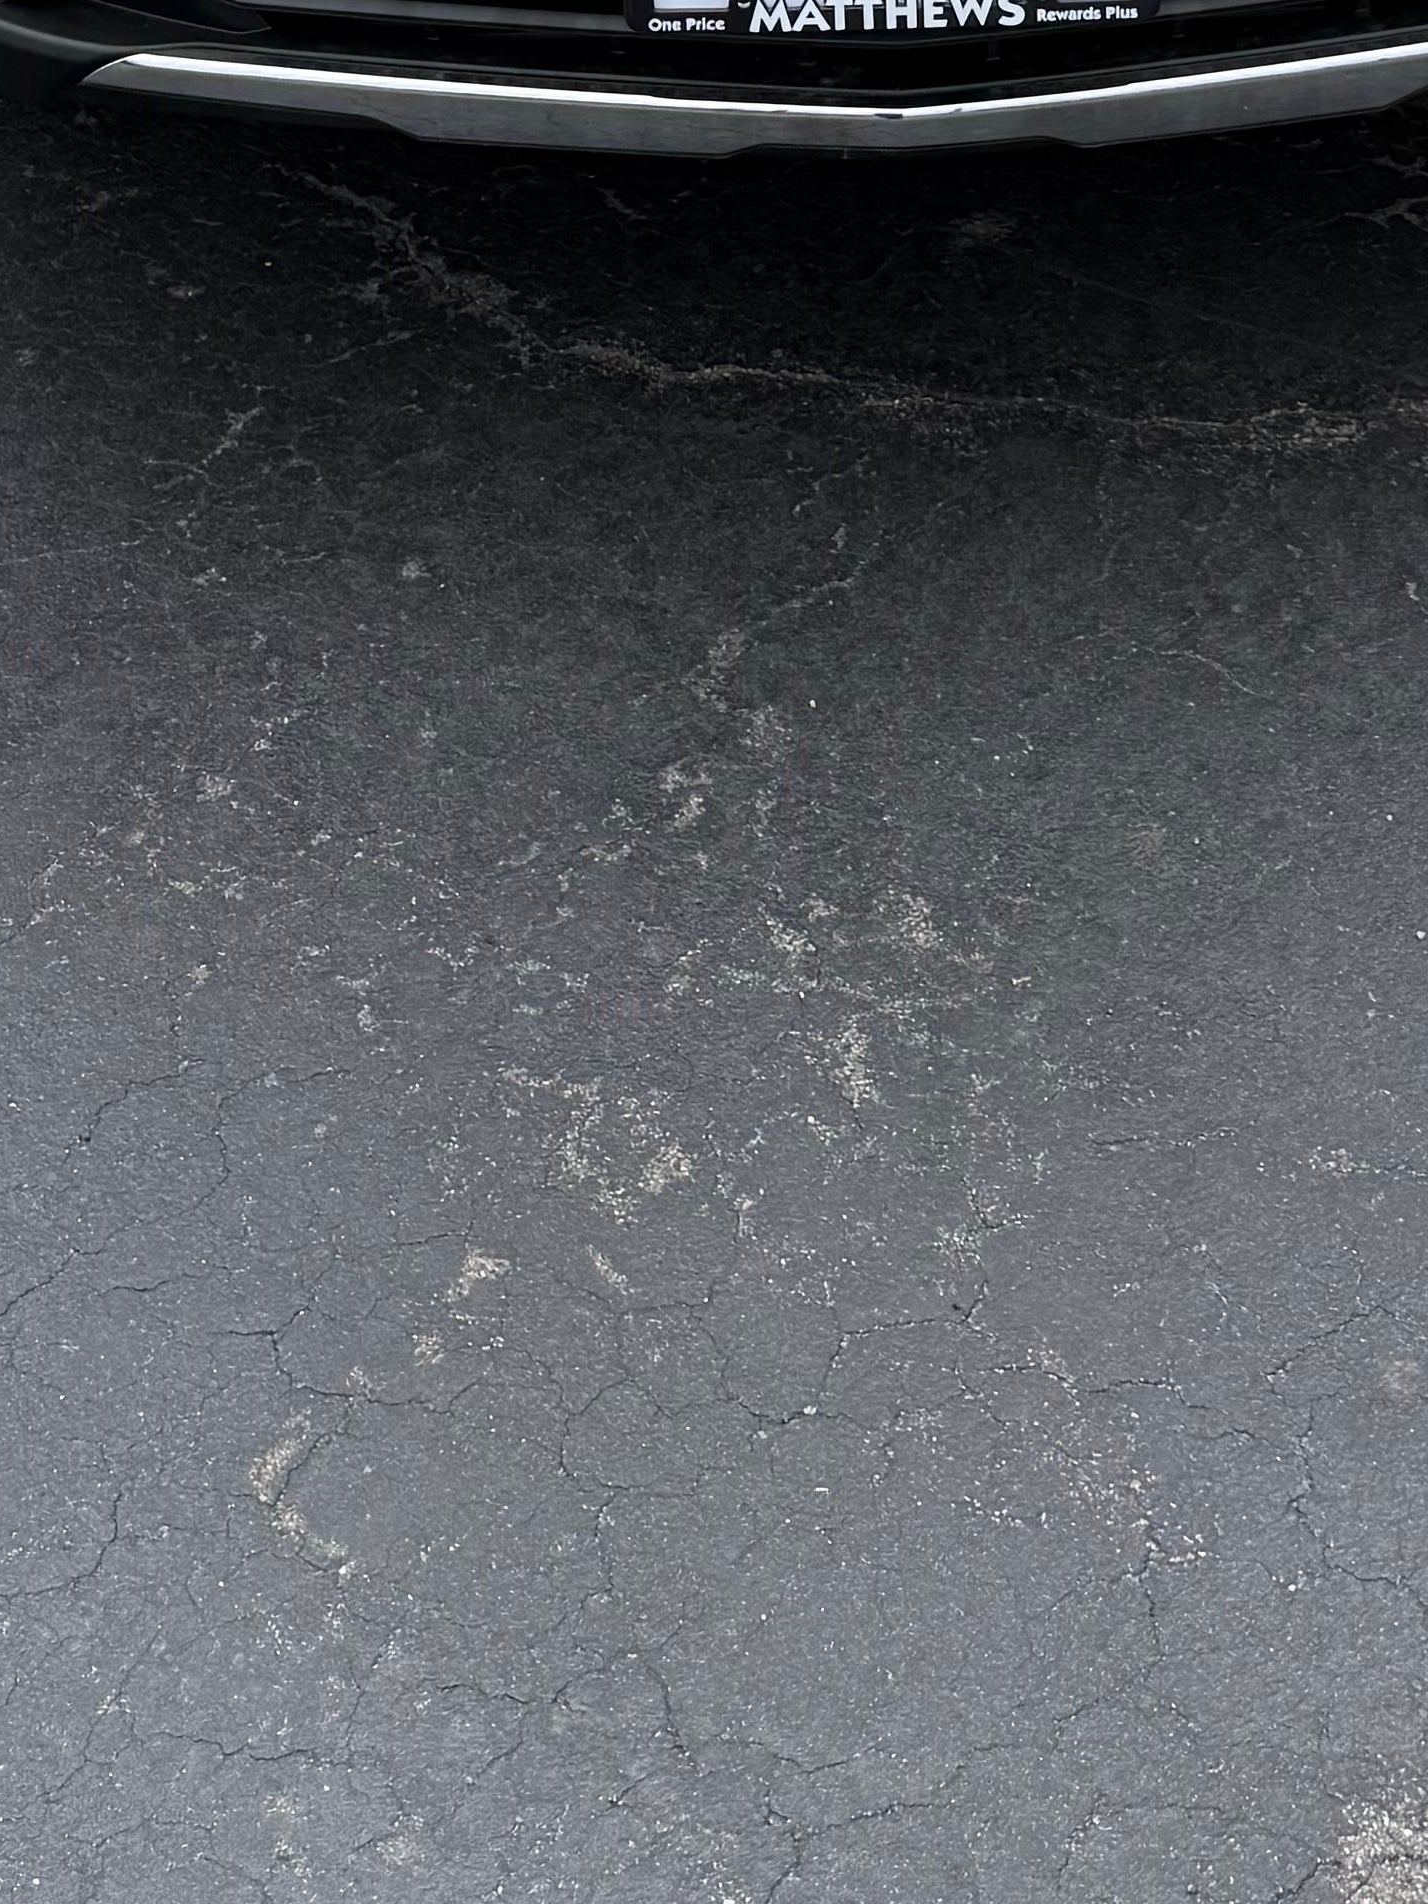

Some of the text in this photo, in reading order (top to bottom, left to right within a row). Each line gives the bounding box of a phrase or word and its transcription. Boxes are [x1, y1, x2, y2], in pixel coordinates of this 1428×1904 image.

[1036, 5, 1139, 23] Rewards Plus
[648, 17, 726, 32] One Price
